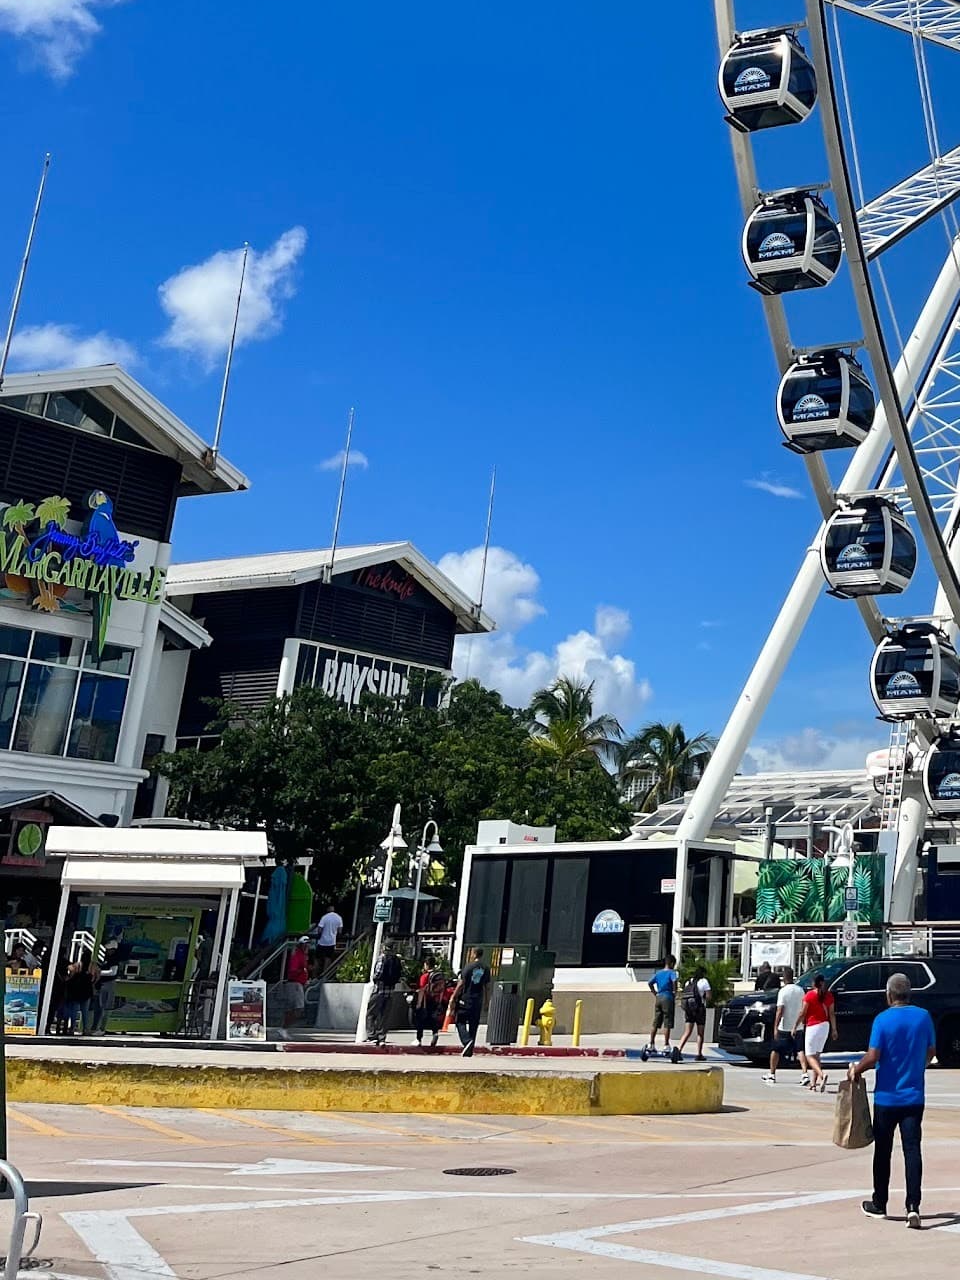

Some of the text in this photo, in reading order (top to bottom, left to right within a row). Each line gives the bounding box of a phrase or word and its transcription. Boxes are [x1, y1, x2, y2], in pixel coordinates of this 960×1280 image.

[734, 81, 771, 93] MIAMI
[758, 246, 795, 259] MIAMI
[792, 409, 829, 421] MIAMI
[0, 530, 166, 605] MARGARITAVILLE
[836, 560, 873, 570] MIAMI
[886, 687, 922, 697] MIAMI
